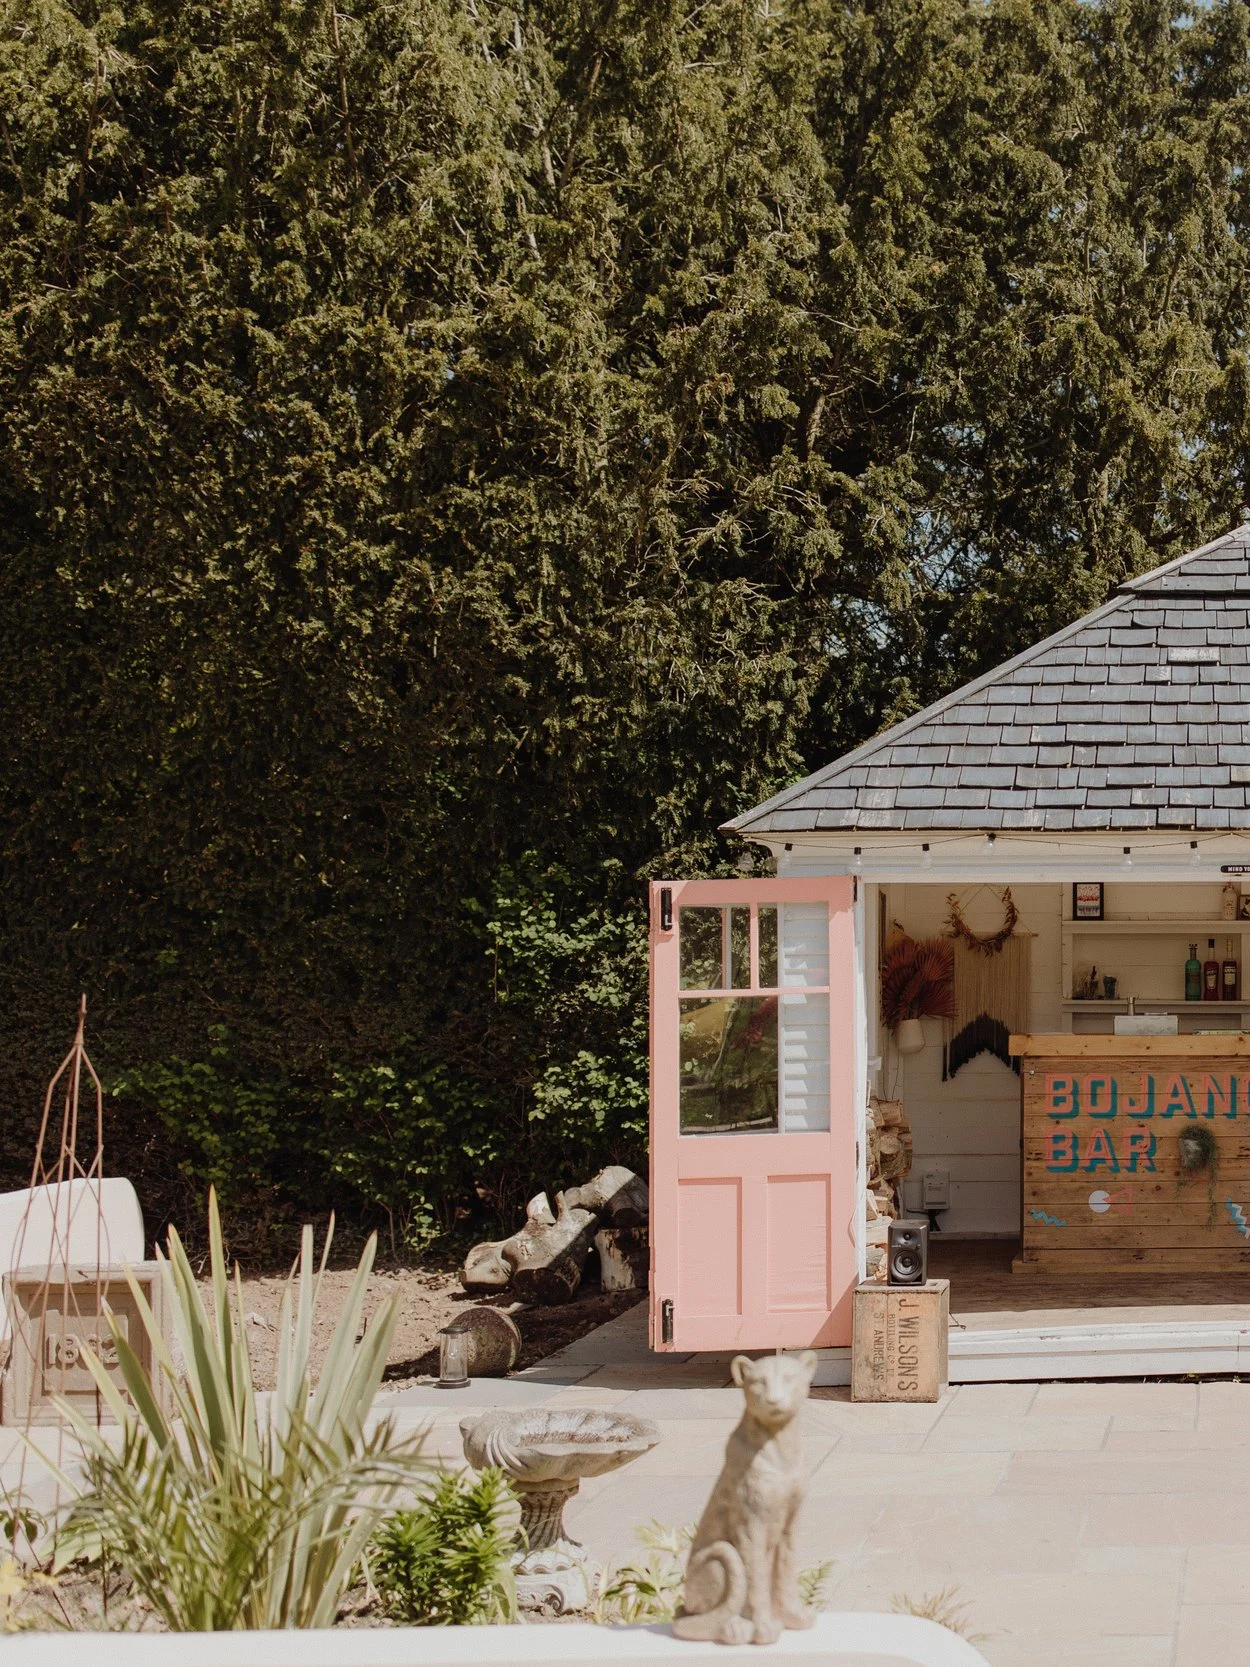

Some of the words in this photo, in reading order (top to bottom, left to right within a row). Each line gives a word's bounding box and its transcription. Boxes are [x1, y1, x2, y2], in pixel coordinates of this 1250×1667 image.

[1044, 1126, 1157, 1174] BAR
[899, 1298, 919, 1311] J.
[873, 1330, 885, 1380] ANDREWS
[897, 1316, 919, 1390] WILSON'S
